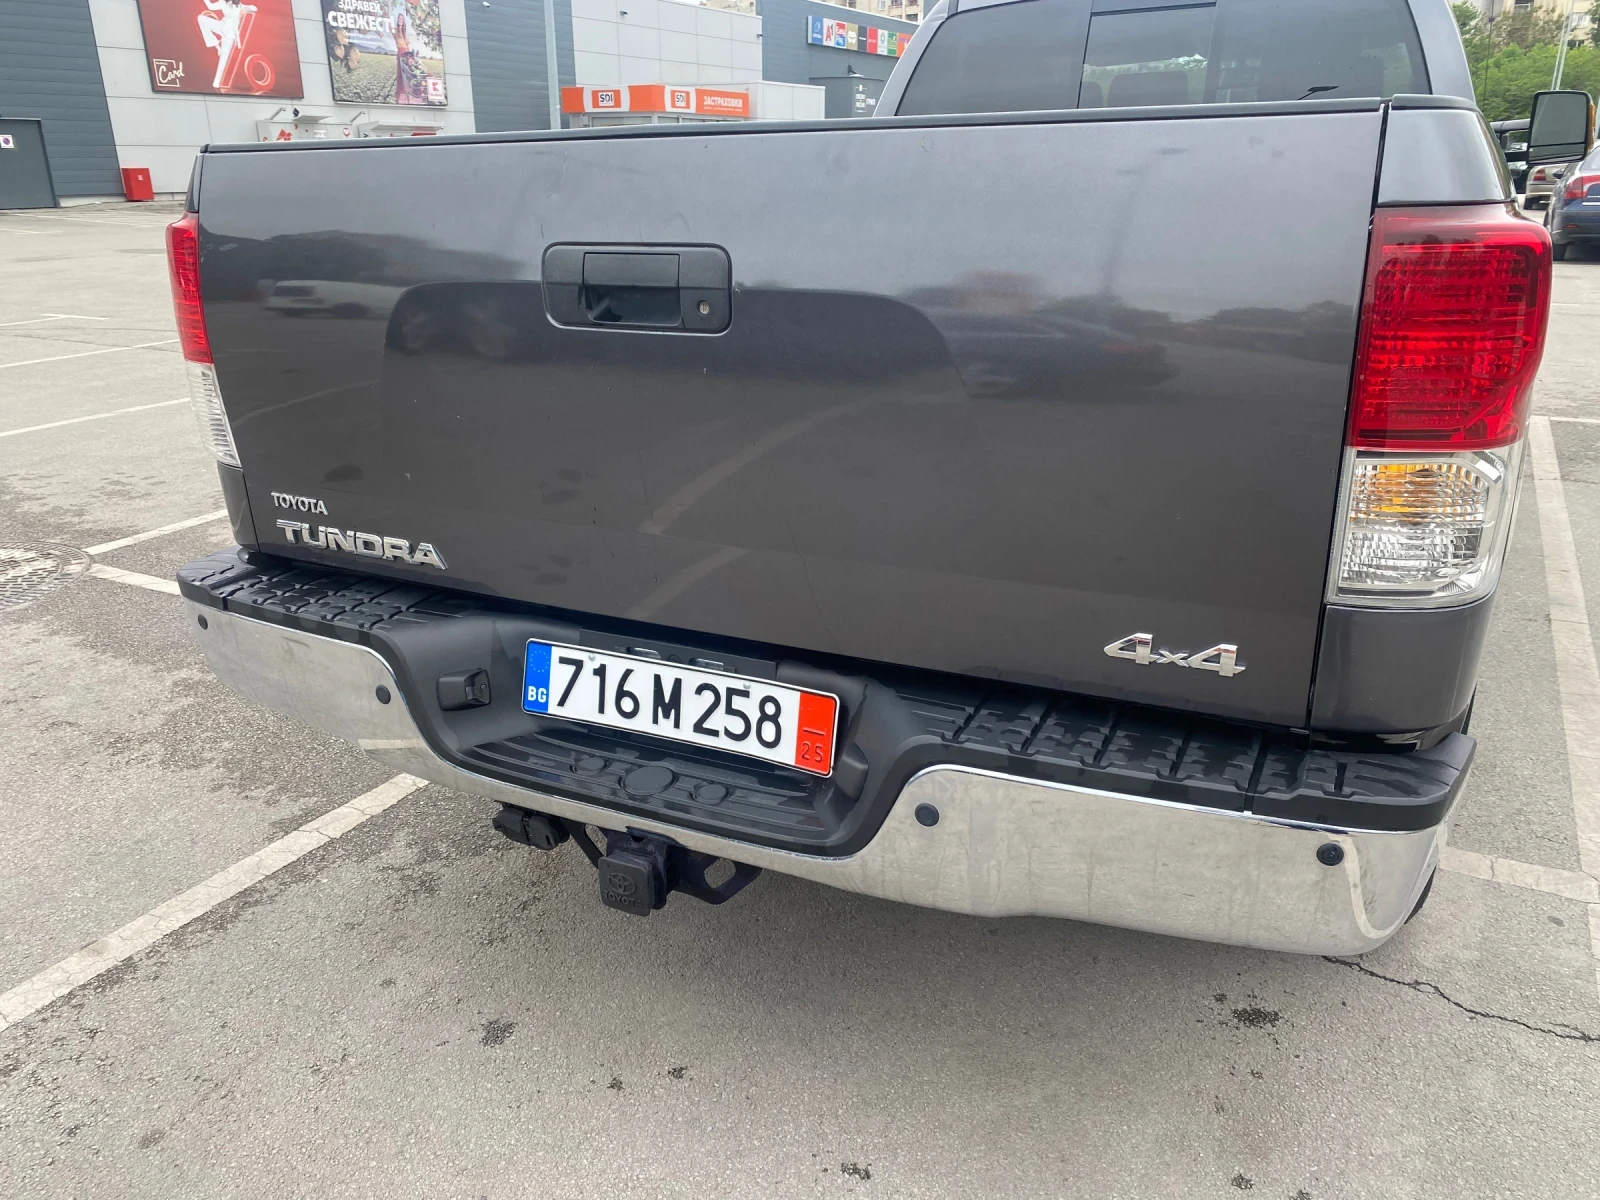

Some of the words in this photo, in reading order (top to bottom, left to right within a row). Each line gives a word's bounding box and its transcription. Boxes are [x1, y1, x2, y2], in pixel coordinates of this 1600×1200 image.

[327, 10, 396, 34] СВЕЖЕСТ!
[158, 61, 185, 83] Card
[600, 93, 613, 103] SDI
[675, 94, 686, 103] SDI
[703, 96, 743, 108] ЗАСТРАХОВКИ
[270, 491, 329, 515] TOYOTA
[276, 518, 448, 570] TUNDRA
[527, 685, 547, 703] BG
[556, 655, 640, 719] 716
[692, 682, 782, 749] 258
[800, 741, 823, 763] 25
[603, 889, 645, 909] TOYOTA
